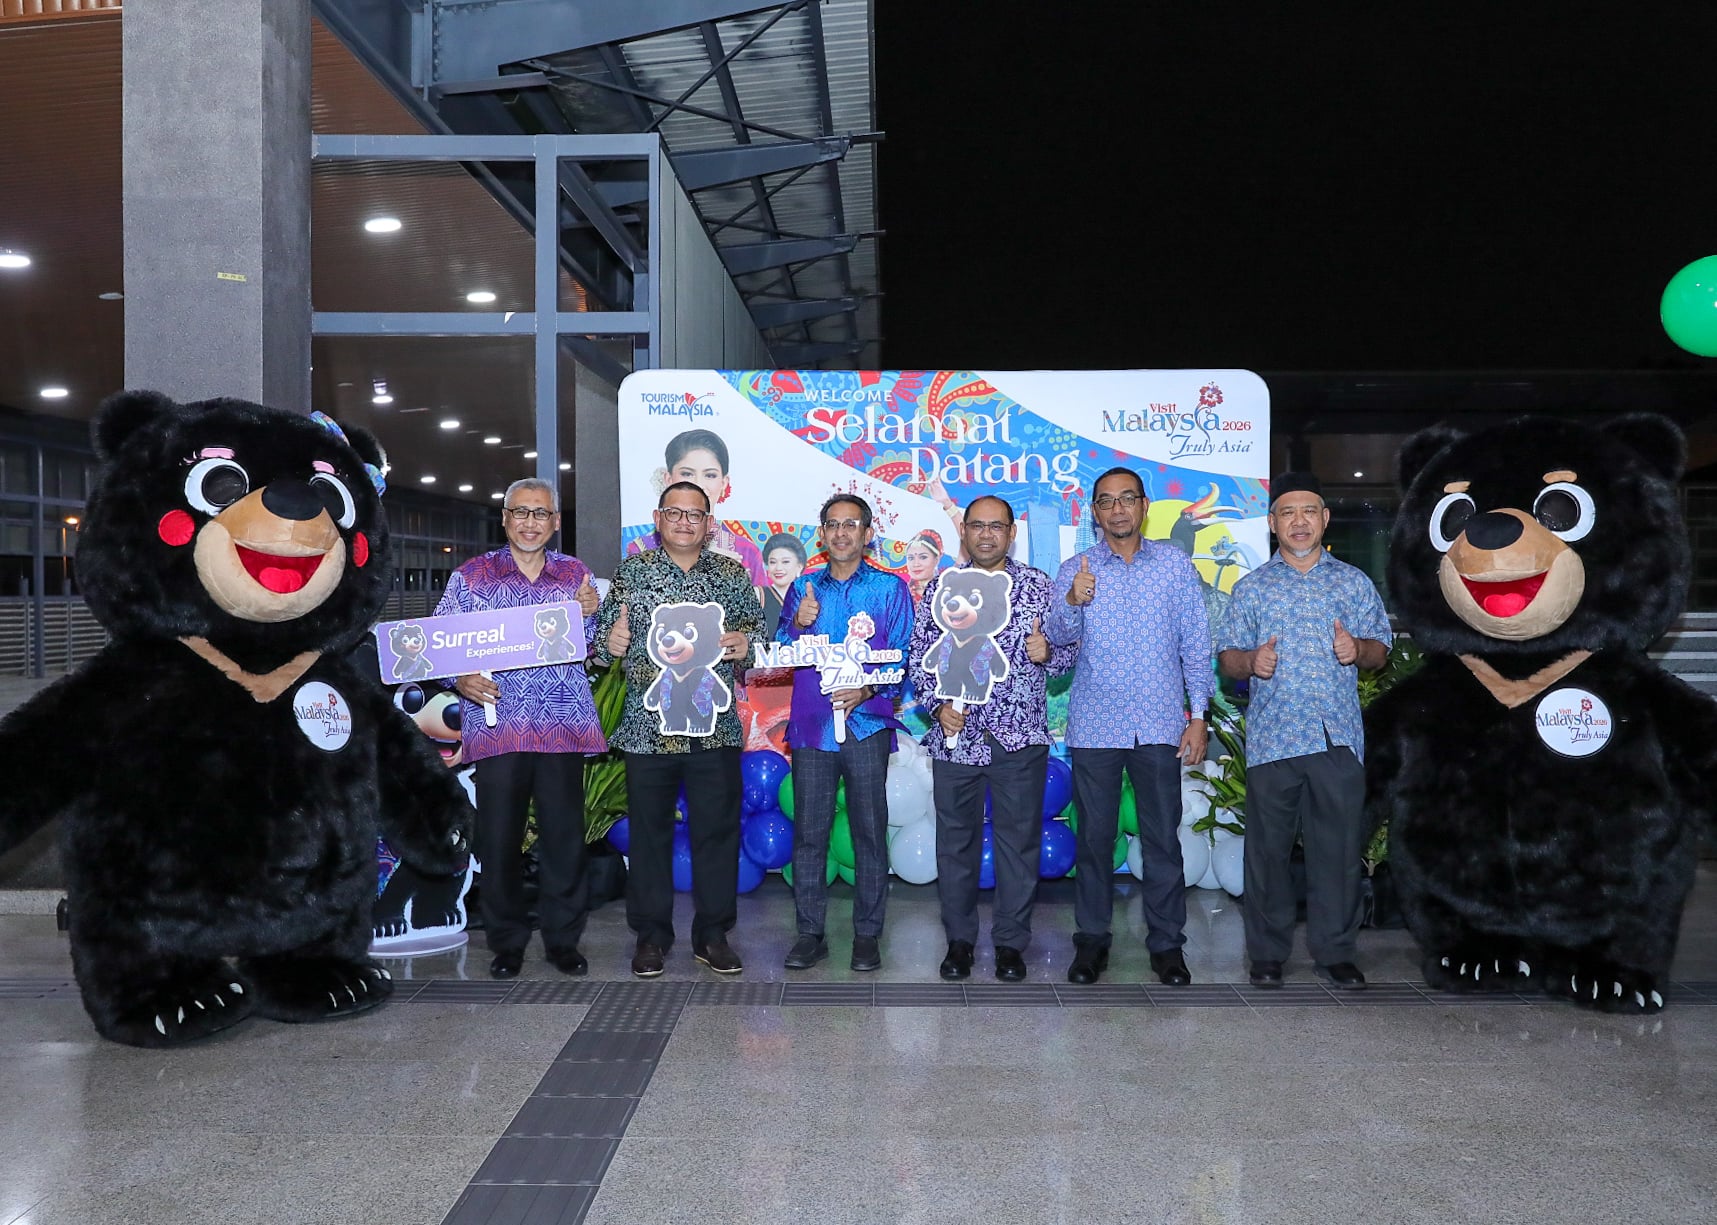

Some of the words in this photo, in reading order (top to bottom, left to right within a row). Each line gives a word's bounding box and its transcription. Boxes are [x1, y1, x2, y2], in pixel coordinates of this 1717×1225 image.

[641, 393, 685, 403] TOURISM
[804, 390, 892, 401] WELCOME
[649, 404, 713, 422] MALAYSIA
[1150, 403, 1176, 413] Visit
[806, 406, 1011, 444] Selamat
[1102, 406, 1221, 437] Malaysia
[1222, 420, 1251, 431] 2026
[1170, 435, 1215, 460] Truly
[1218, 440, 1251, 453] Asia
[909, 447, 1080, 493] Datang
[432, 623, 505, 649] Surreal
[801, 636, 828, 646] Visit
[466, 640, 535, 658] Experiences!
[755, 641, 870, 669] Malaysia
[873, 650, 901, 661] 2026
[822, 666, 865, 691] Truly
[869, 670, 901, 684] Asia
[1537, 711, 1594, 730] Malaysia
[1570, 727, 1592, 743] Truly
